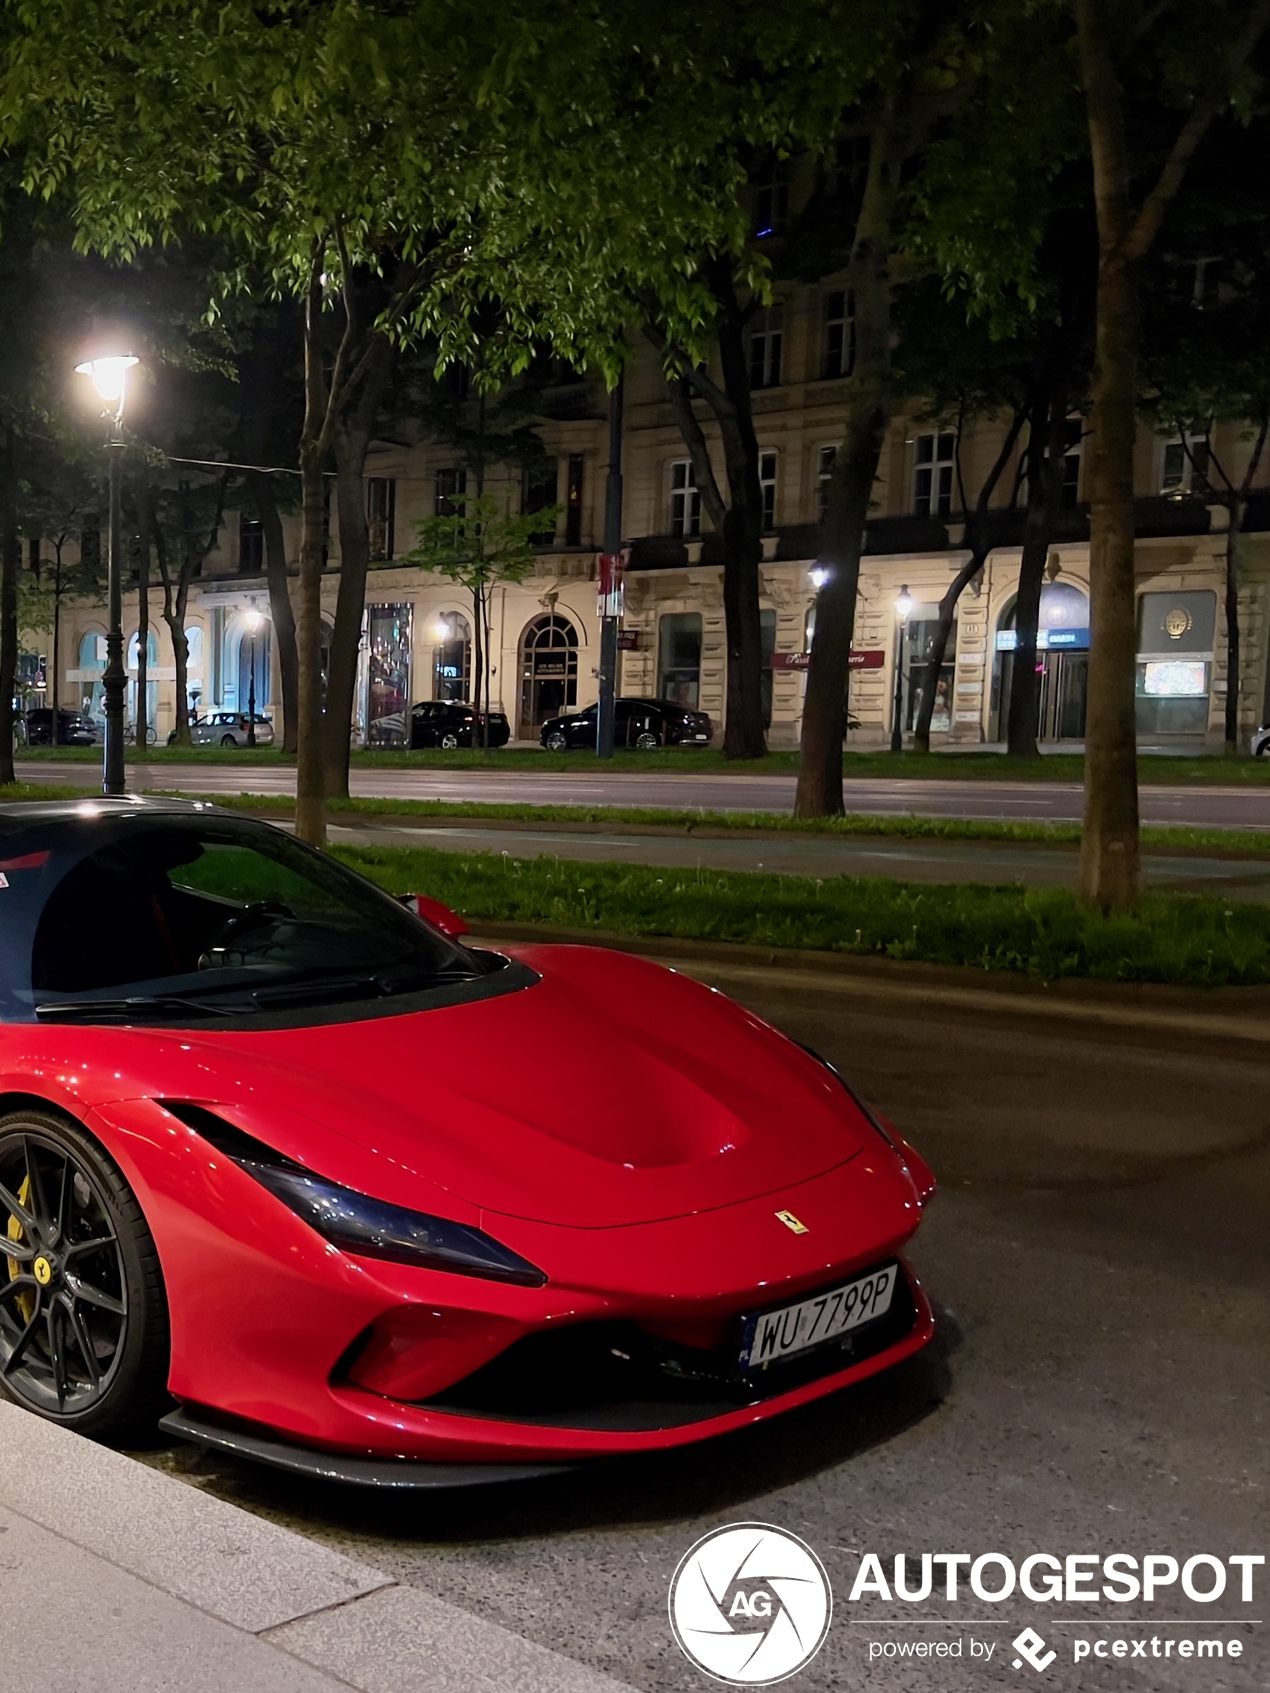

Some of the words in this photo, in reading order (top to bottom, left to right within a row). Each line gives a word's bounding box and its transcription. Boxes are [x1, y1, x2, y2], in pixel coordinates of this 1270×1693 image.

[759, 1308, 802, 1359] WU
[807, 1272, 890, 1342] 7799P
[738, 1349, 749, 1362] PL
